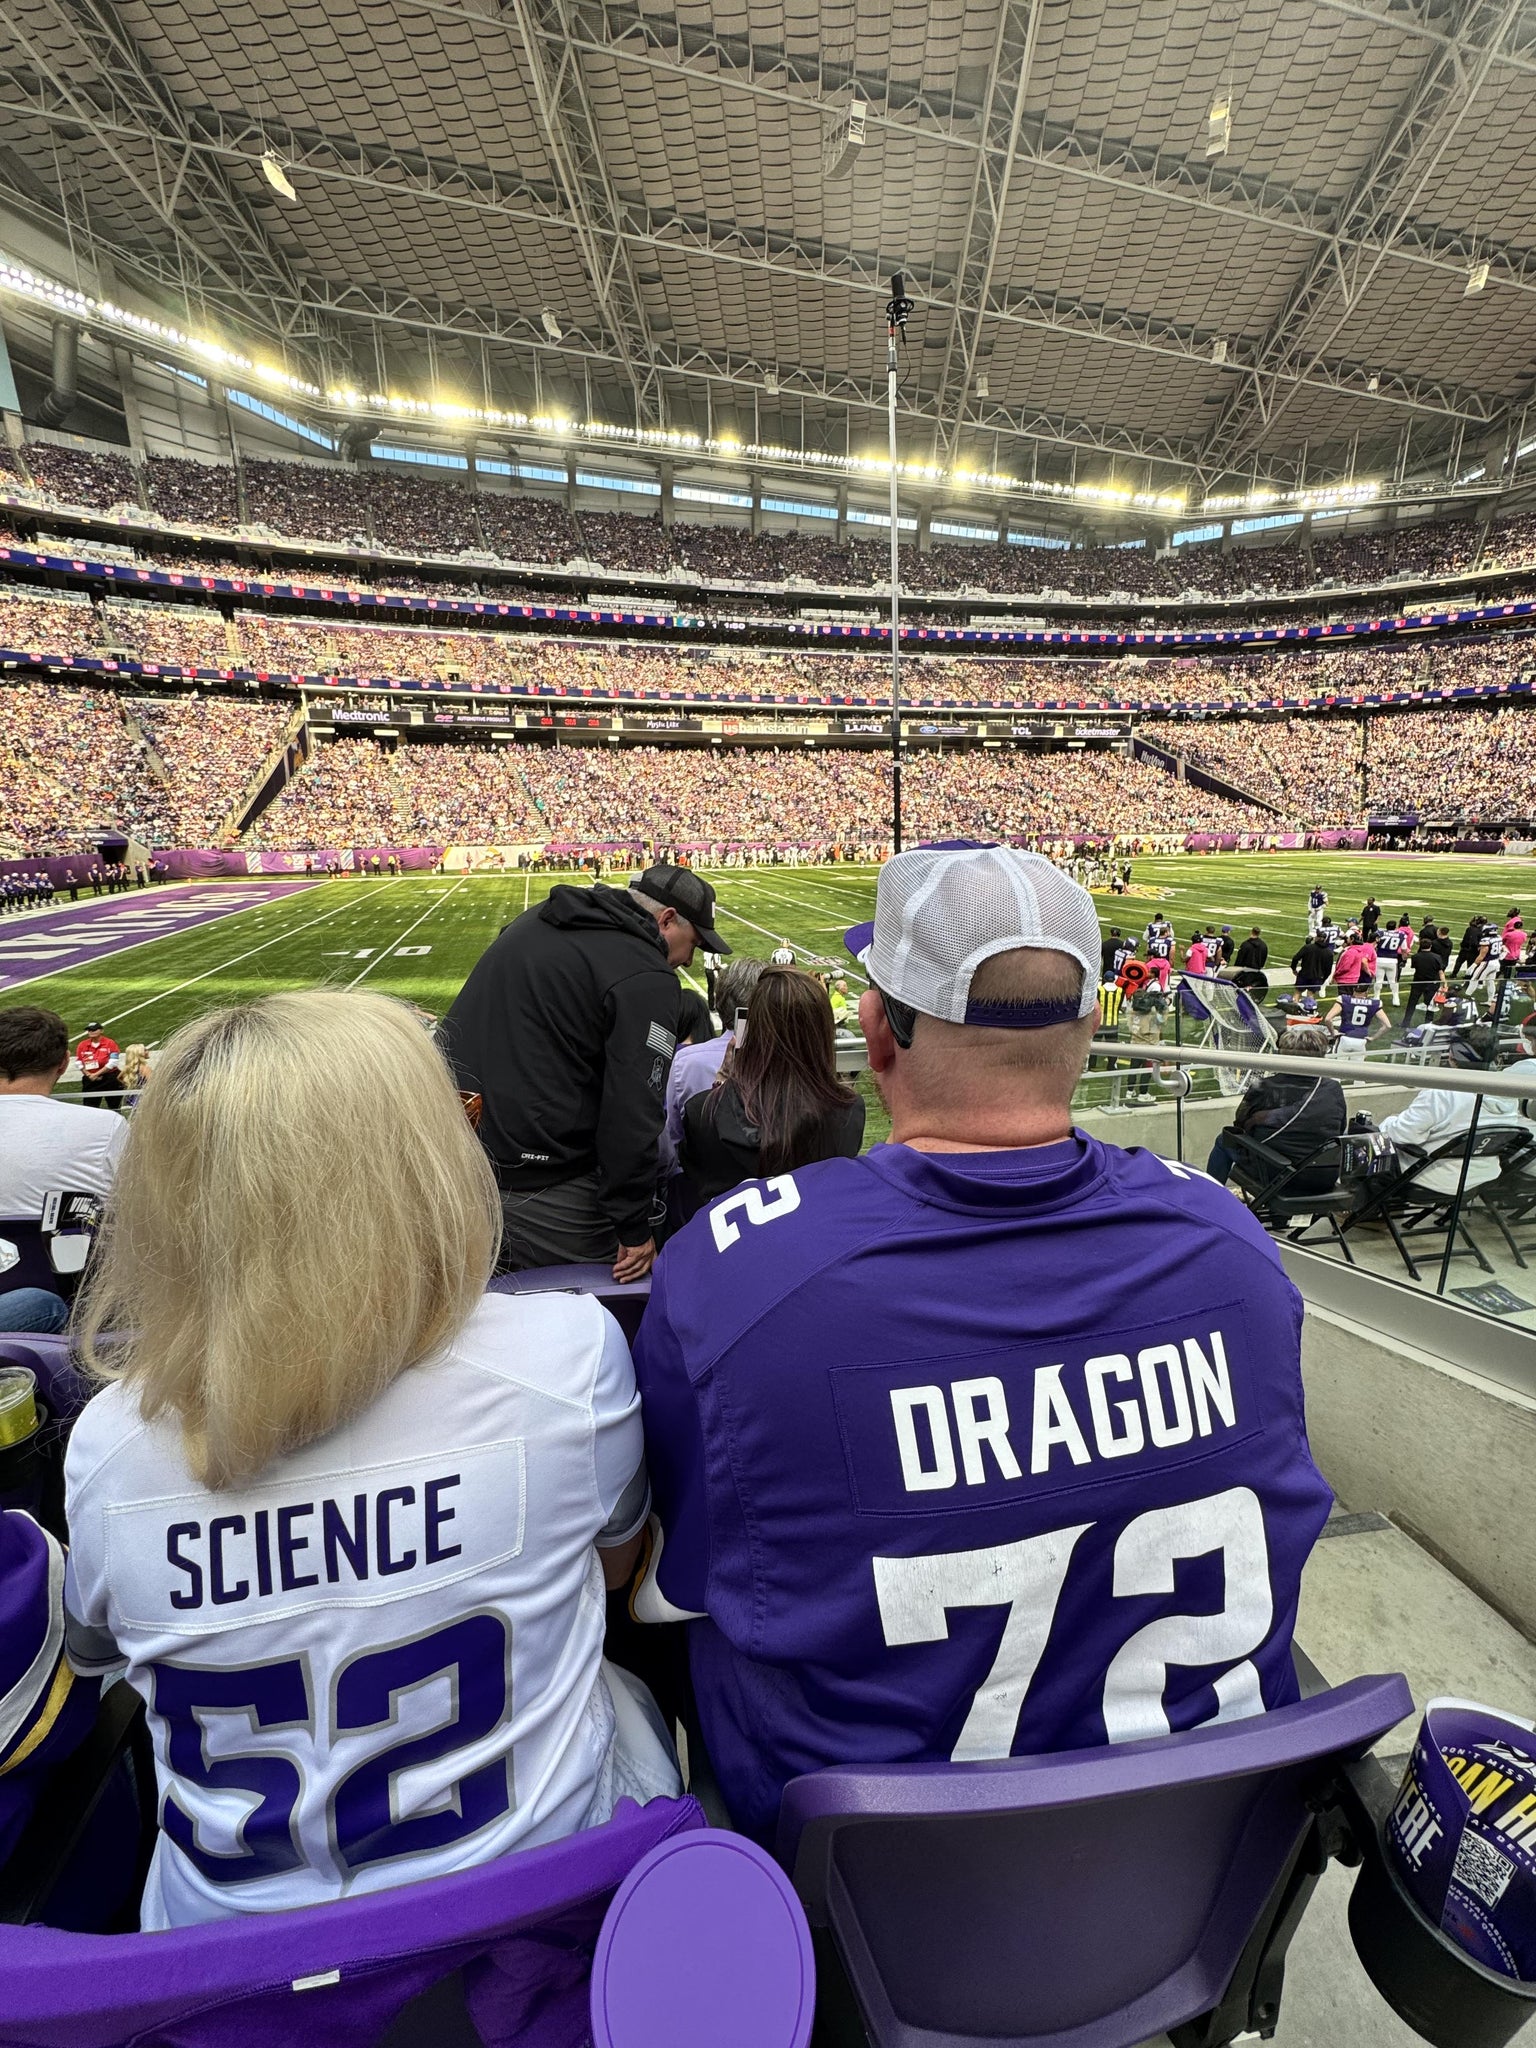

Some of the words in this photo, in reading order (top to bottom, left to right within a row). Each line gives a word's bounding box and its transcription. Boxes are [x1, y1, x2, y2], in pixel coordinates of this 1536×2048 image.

[332, 709, 390, 723] Medtronic
[541, 717, 553, 725] 3M
[564, 718, 577, 726] 3M
[845, 723, 884, 733] LUND
[1011, 726, 1032, 735] TCL
[1075, 727, 1121, 737] ticketmaster
[1381, 936, 1400, 949] 78
[1351, 1005, 1368, 1026] 6
[889, 1331, 1236, 1491] DRAGON
[167, 1474, 462, 1610] SCIENCE
[872, 1486, 1274, 1763] 72
[146, 1606, 517, 1893] 52
[1486, 1759, 1525, 1782] MISS
[1442, 1754, 1515, 1816] CAN
